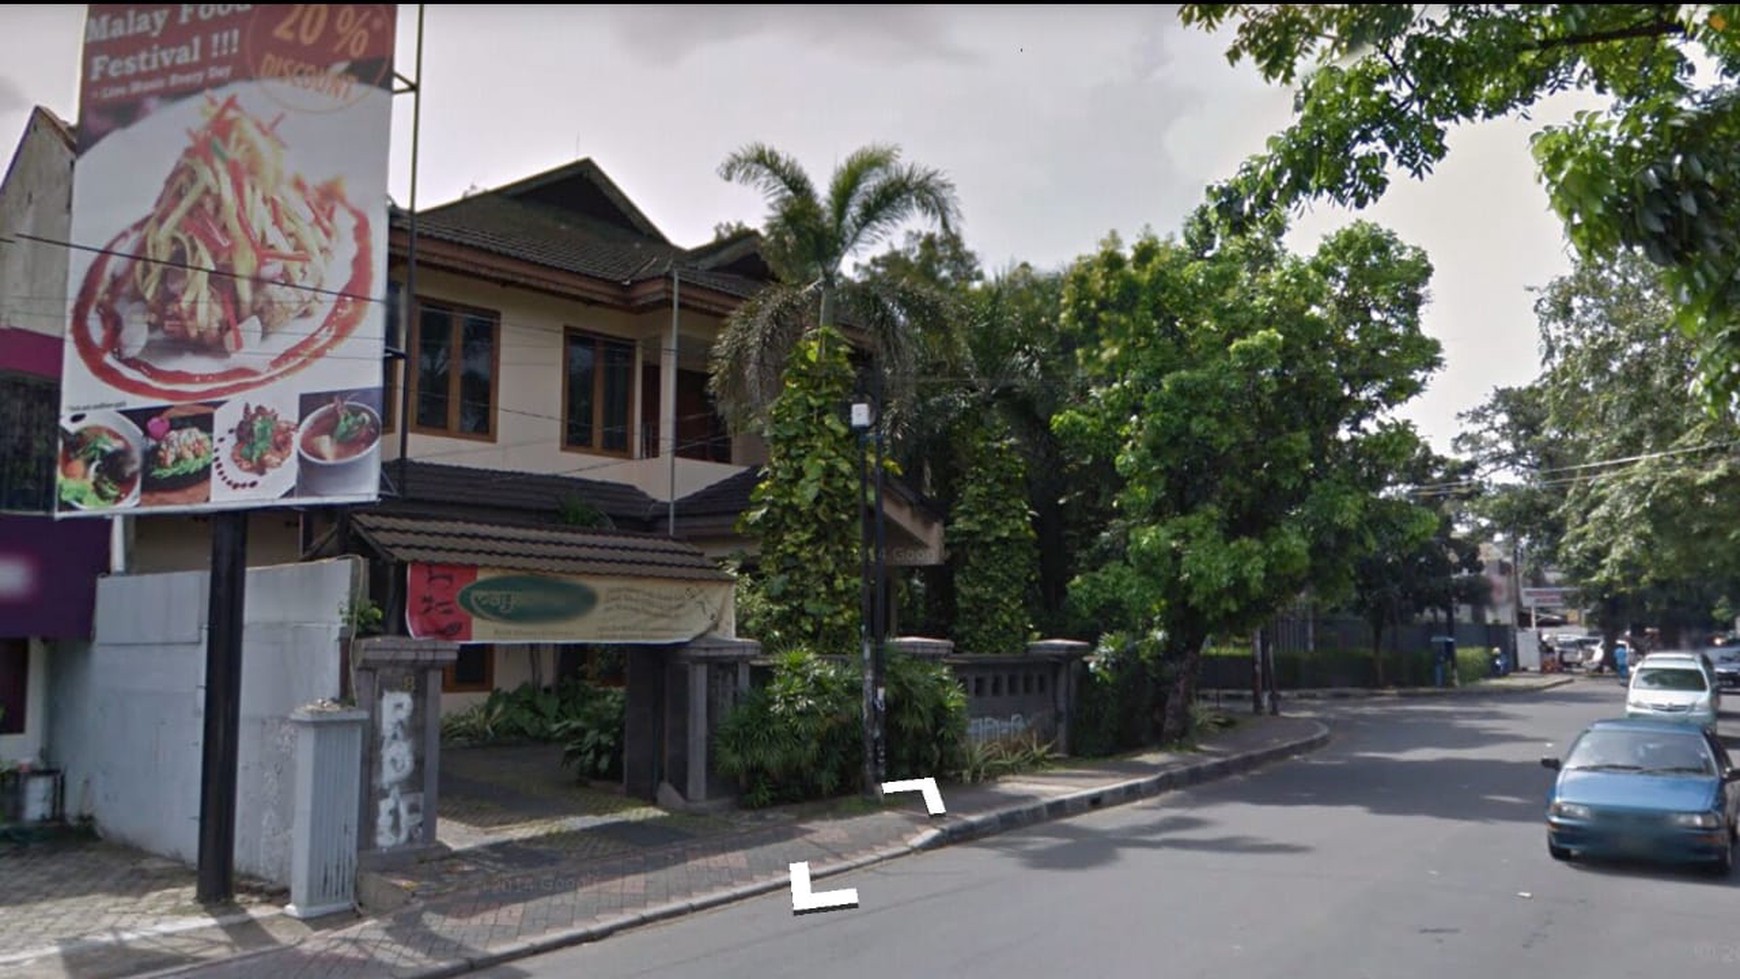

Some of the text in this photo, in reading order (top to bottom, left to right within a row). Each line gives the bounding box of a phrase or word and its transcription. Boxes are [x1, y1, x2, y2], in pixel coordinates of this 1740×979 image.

[86, 9, 169, 43] Malay
[90, 29, 241, 82] Festival !!!
[260, 53, 358, 101] DISCOUNT
